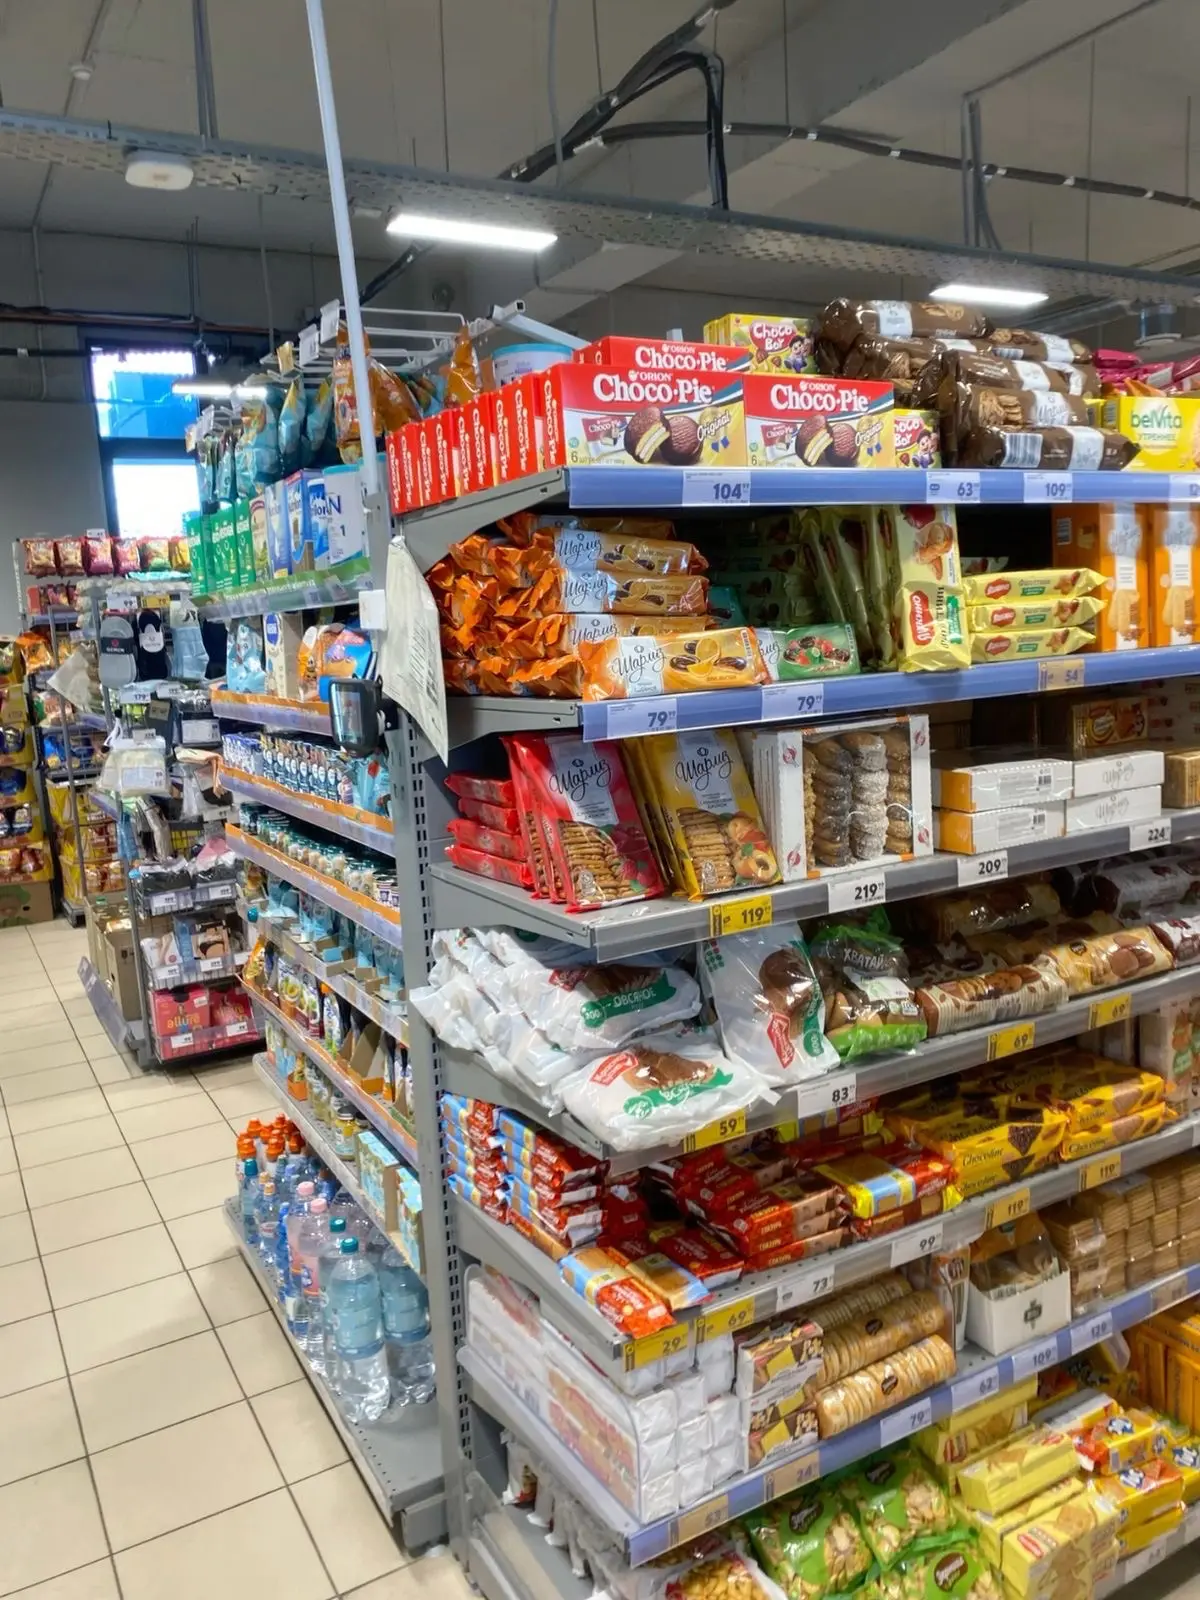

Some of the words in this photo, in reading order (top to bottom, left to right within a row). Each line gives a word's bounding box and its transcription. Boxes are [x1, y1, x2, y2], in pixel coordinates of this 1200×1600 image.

[637, 371, 672, 381] ORION
[895, 417, 920, 431] hoco
[1131, 405, 1183, 428] belVita
[696, 409, 731, 442] Original
[571, 452, 578, 463] 6
[751, 455, 757, 465] 6
[713, 483, 742, 499] 104
[957, 482, 973, 496] 63
[1045, 482, 1067, 496] 109
[797, 696, 815, 711] 79
[648, 710, 667, 727] 79
[1148, 827, 1166, 841] 224
[978, 859, 1001, 875] 209
[854, 883, 878, 900] 219
[741, 907, 764, 924] 119
[832, 1087, 849, 1103] 83
[719, 1118, 737, 1136] 59
[919, 1235, 936, 1250] 99
[813, 1280, 828, 1293] 73
[728, 1312, 745, 1327] 69
[662, 1337, 681, 1353] 29
[910, 1410, 925, 1426] 79
